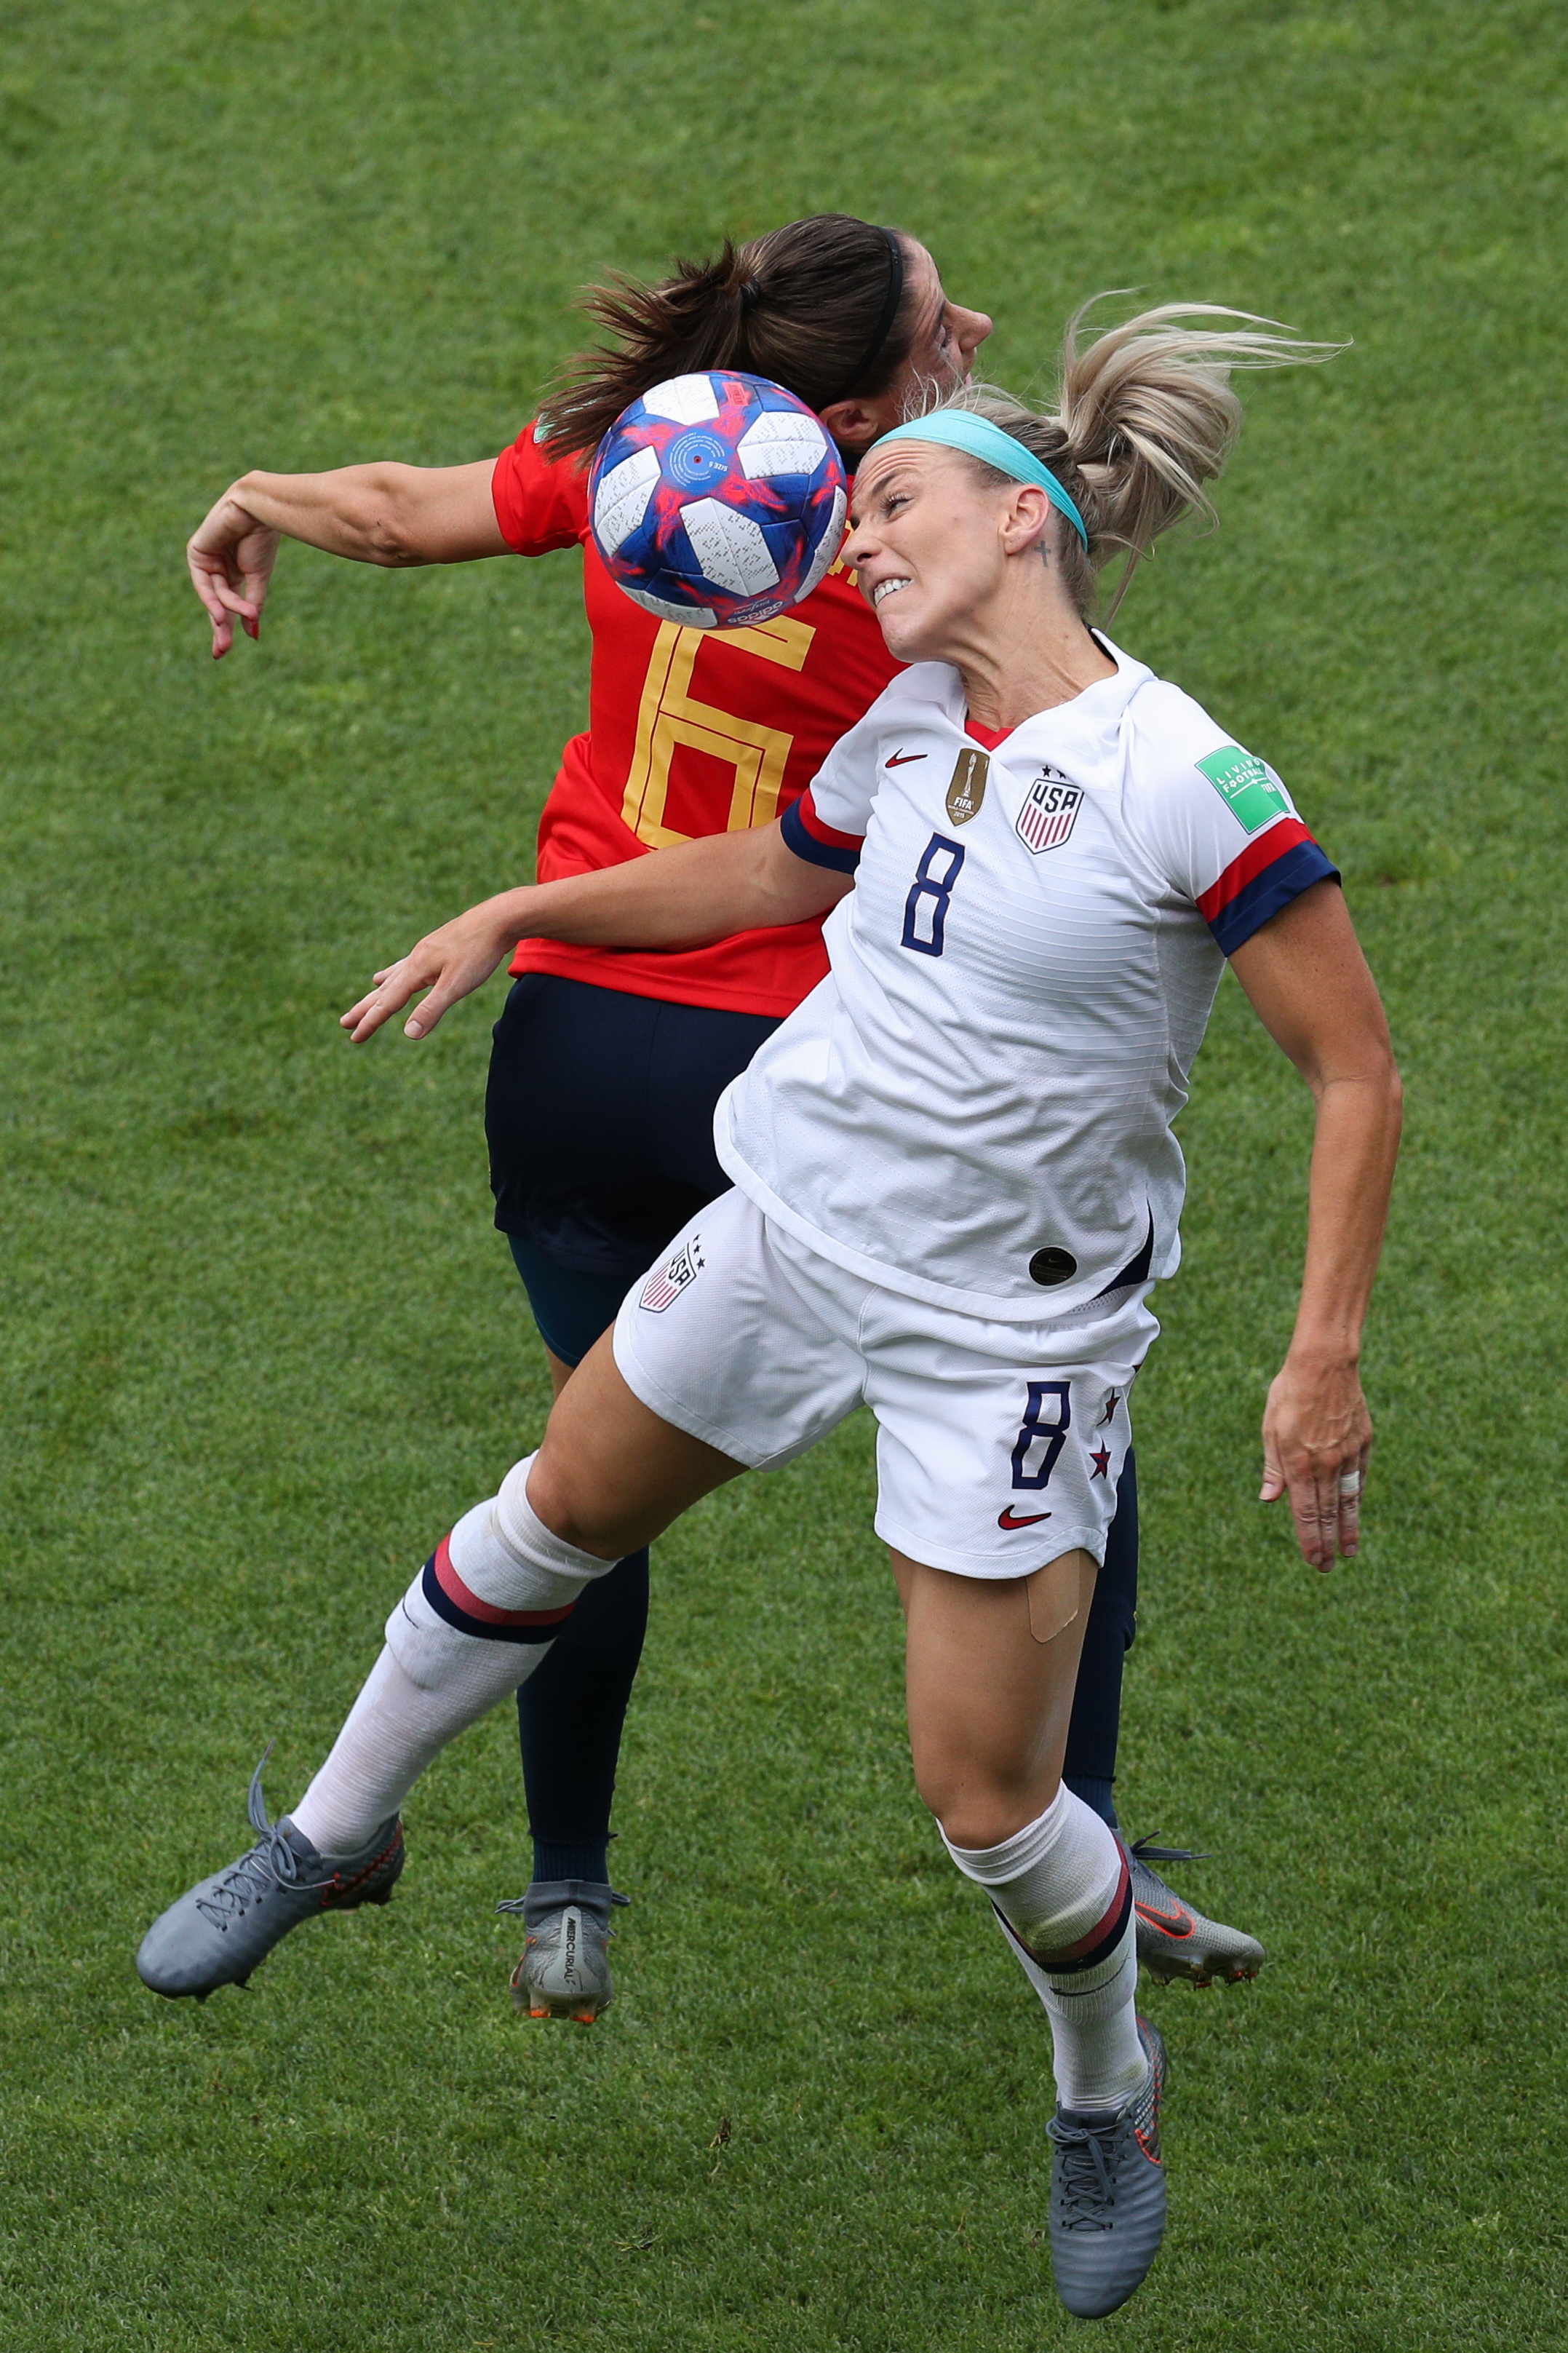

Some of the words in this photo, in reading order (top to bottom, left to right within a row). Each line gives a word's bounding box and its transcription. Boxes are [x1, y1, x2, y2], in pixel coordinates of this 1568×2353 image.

[713, 461, 728, 472] SIZE
[727, 600, 784, 624] adidas
[620, 614, 817, 850] 6
[1216, 758, 1260, 785] LIVING
[953, 796, 972, 810] FIFA
[1032, 784, 1079, 813] USA
[900, 831, 966, 959] 8
[668, 1247, 691, 1286] USA
[1011, 1381, 1072, 1491] 8
[563, 1916, 576, 1979] MERCURIAL
